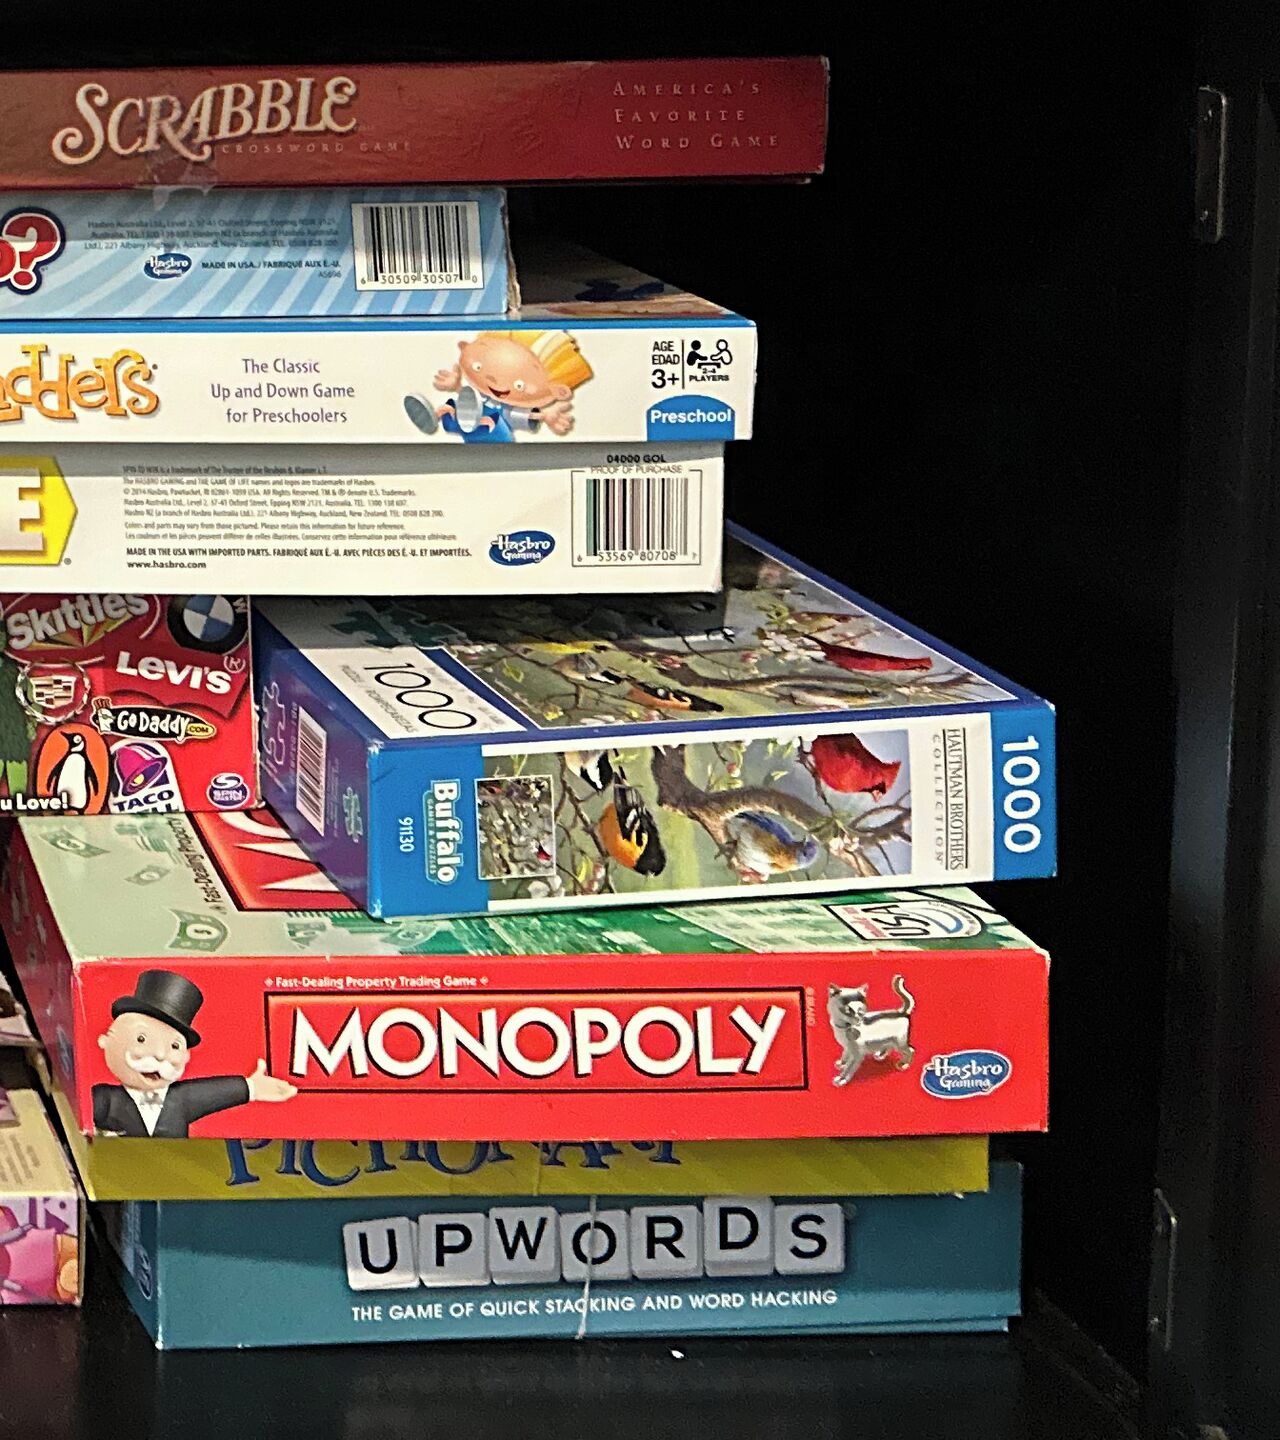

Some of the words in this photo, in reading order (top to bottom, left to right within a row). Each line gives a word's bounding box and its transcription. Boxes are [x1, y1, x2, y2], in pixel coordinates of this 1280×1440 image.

[51, 75, 357, 166] SCRABBLE
[241, 359, 270, 374] The
[273, 358, 320, 375] Classic
[210, 384, 231, 400] Up
[234, 383, 262, 398] and
[266, 383, 308, 398] Down
[312, 383, 355, 398] Game
[226, 408, 248, 423] for
[252, 407, 348, 424] Preschoolers
[650, 408, 732, 425] Preschool
[127, 561, 207, 569] www.hasbro.com
[491, 534, 551, 551] Hasbro
[6, 593, 149, 651] Skittles
[364, 663, 477, 730] 1000
[947, 729, 964, 797] HAUTMAN
[16, 792, 69, 811] Love!
[1002, 735, 1041, 853] 1000
[432, 781, 462, 883] Buffalo
[950, 803, 964, 870] BROTHERS
[869, 904, 926, 938] USA
[291, 1004, 787, 1080] MONOPOLY
[357, 1206, 829, 1274] UPWORDS
[351, 1305, 382, 1321] THE
[389, 1303, 443, 1320] GAME
[450, 1302, 476, 1318] OF
[480, 1299, 539, 1318] QUICK
[544, 1295, 636, 1315] STACKING
[642, 1294, 683, 1311] AND
[688, 1293, 745, 1309] WORD
[751, 1290, 838, 1308] HACKING
